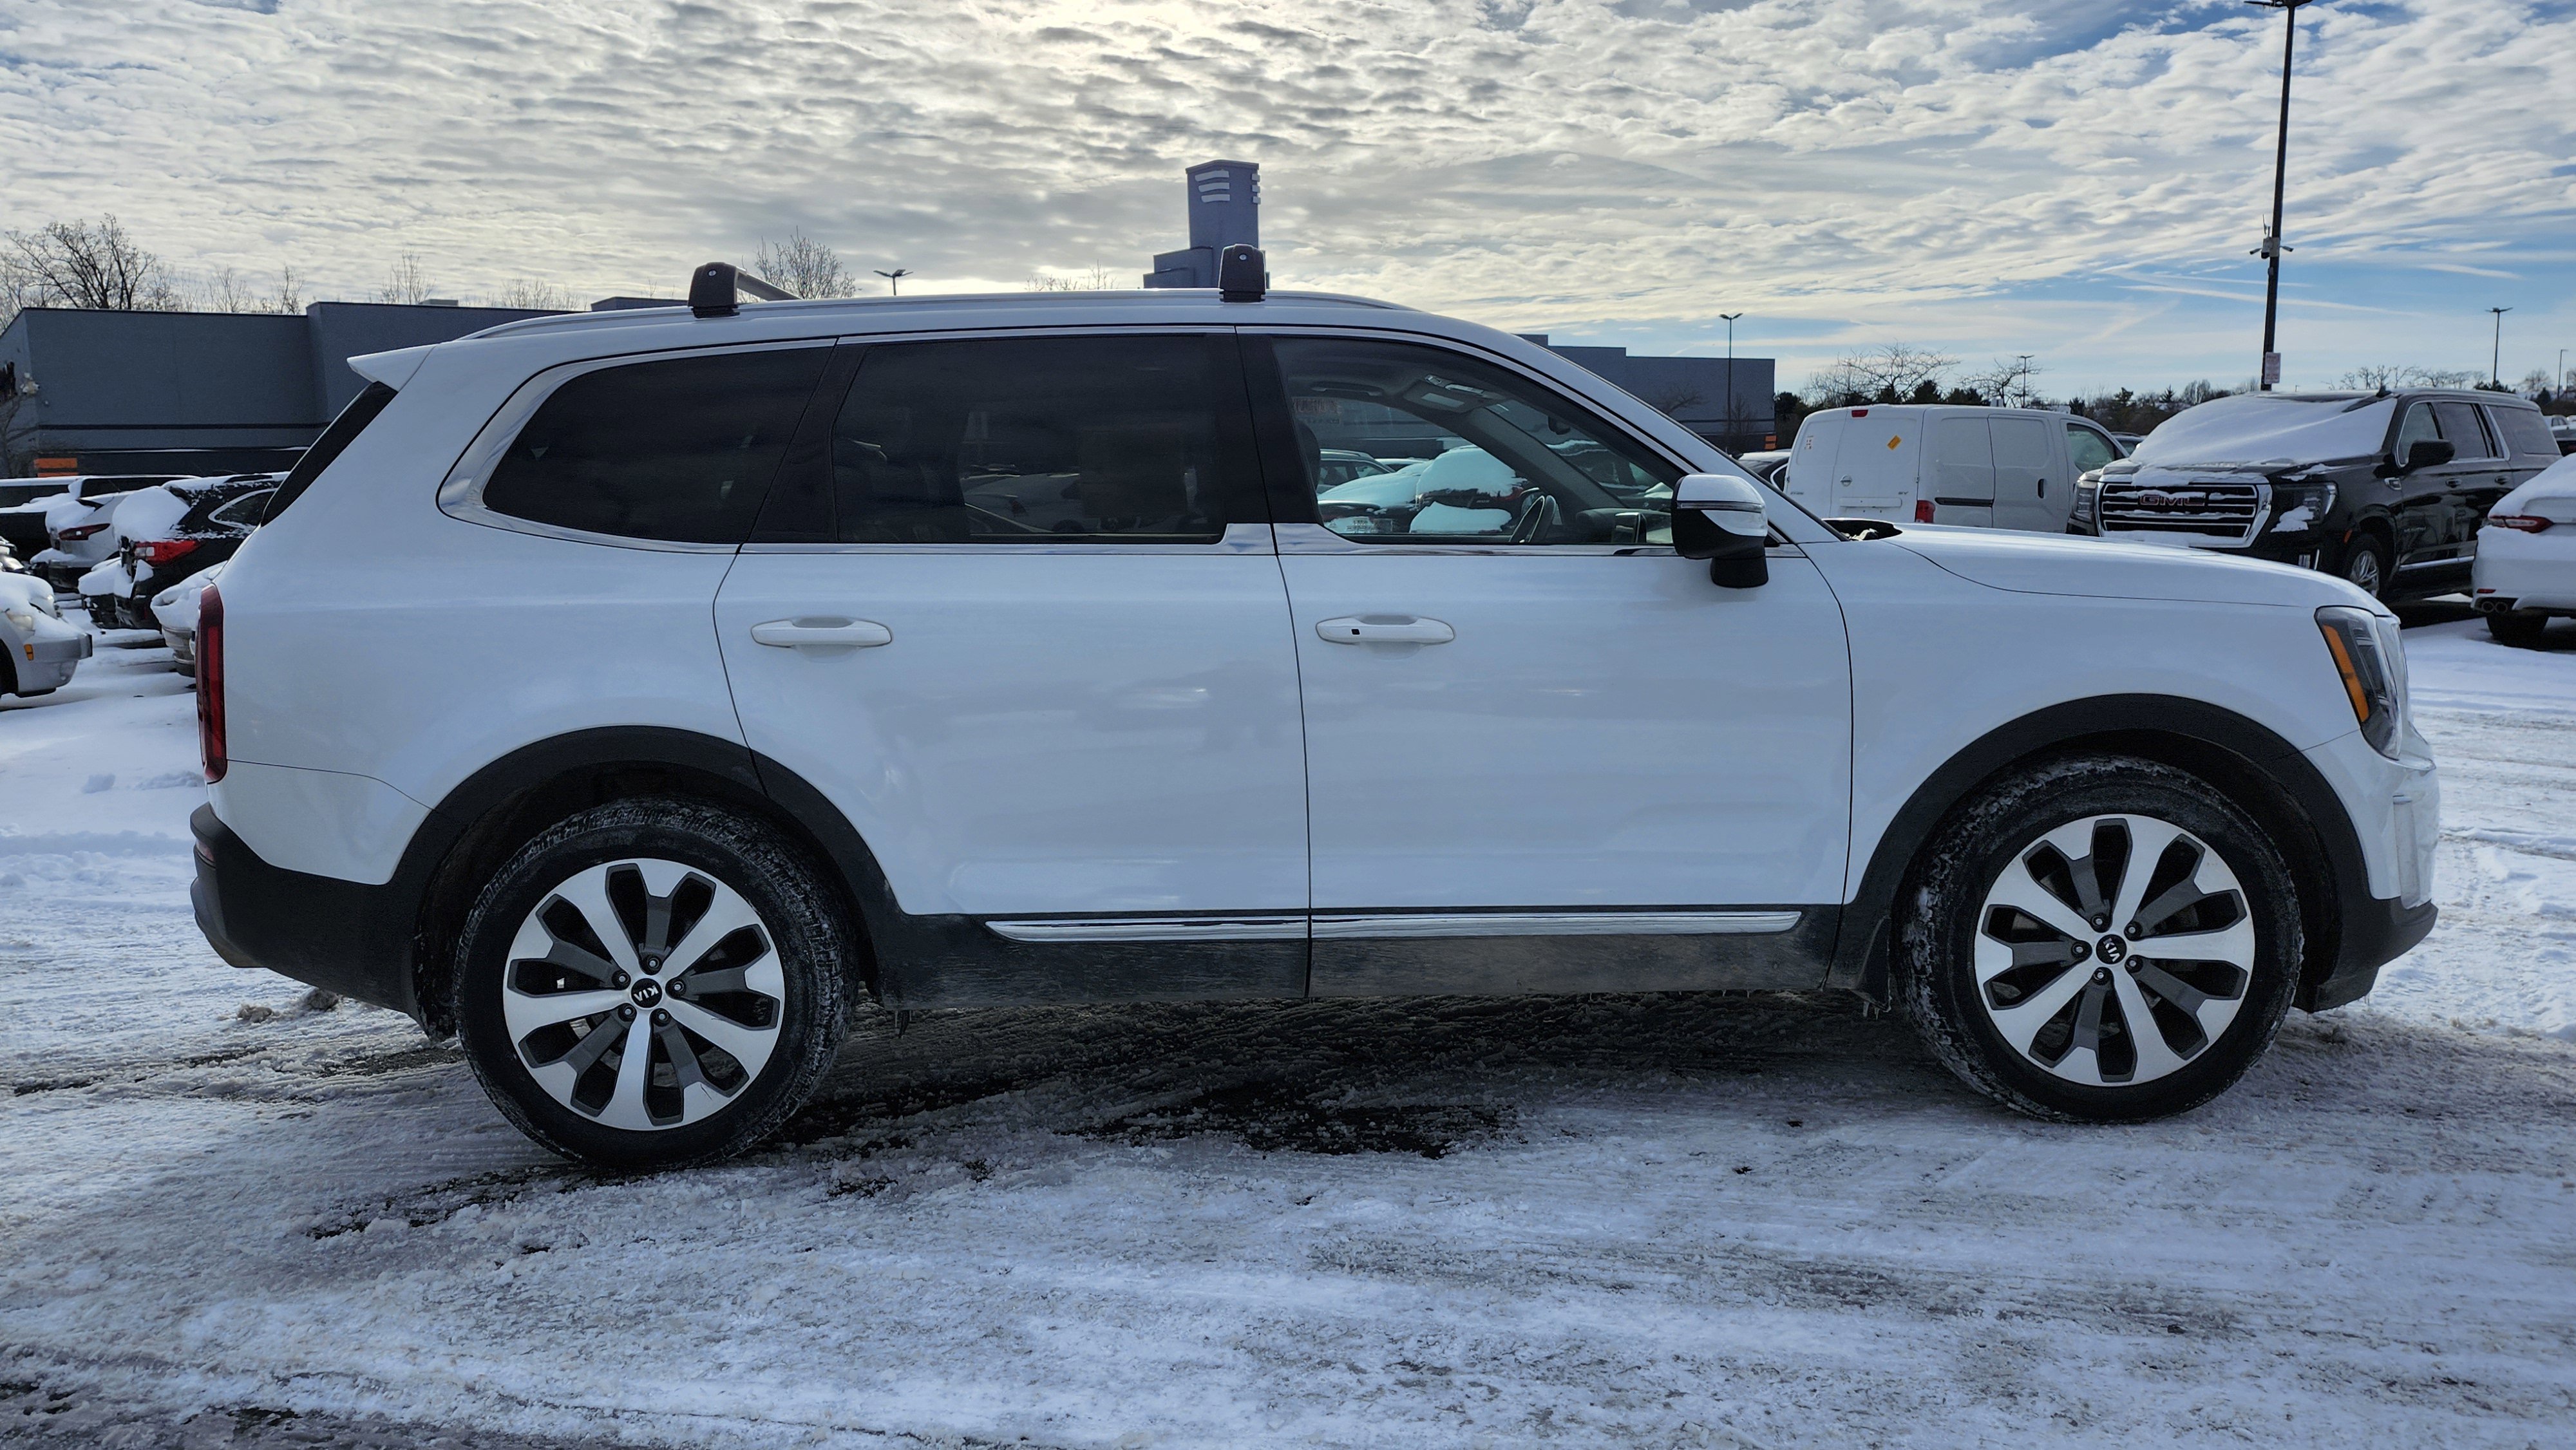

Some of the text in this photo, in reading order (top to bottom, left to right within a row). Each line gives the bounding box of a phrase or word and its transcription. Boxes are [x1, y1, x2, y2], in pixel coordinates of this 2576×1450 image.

[2139, 493, 2206, 507] GMC
[2103, 937, 2121, 963] KIA
[633, 984, 659, 1002] KIA
